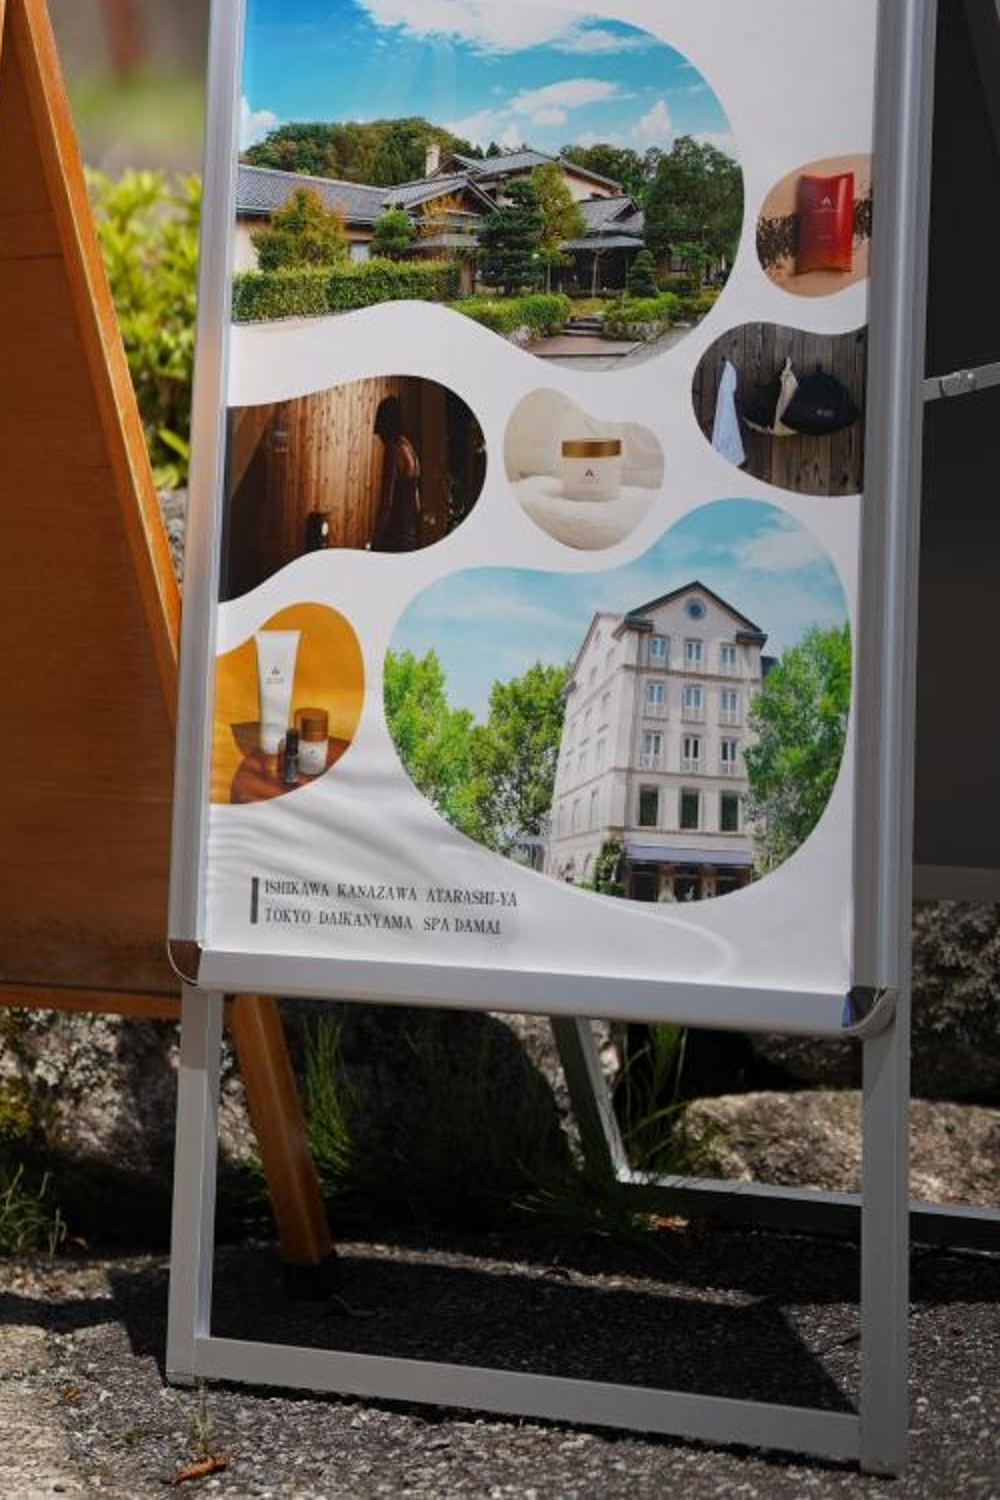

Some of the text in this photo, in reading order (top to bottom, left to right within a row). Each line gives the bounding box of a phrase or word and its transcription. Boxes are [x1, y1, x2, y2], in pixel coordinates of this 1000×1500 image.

[265, 879, 518, 907] ISHIKAWA KANAZAWA ATARASHI-YA
[265, 907, 312, 925] TOKYO
[319, 911, 413, 931] DAIKANYAMA
[423, 917, 450, 933] SPA
